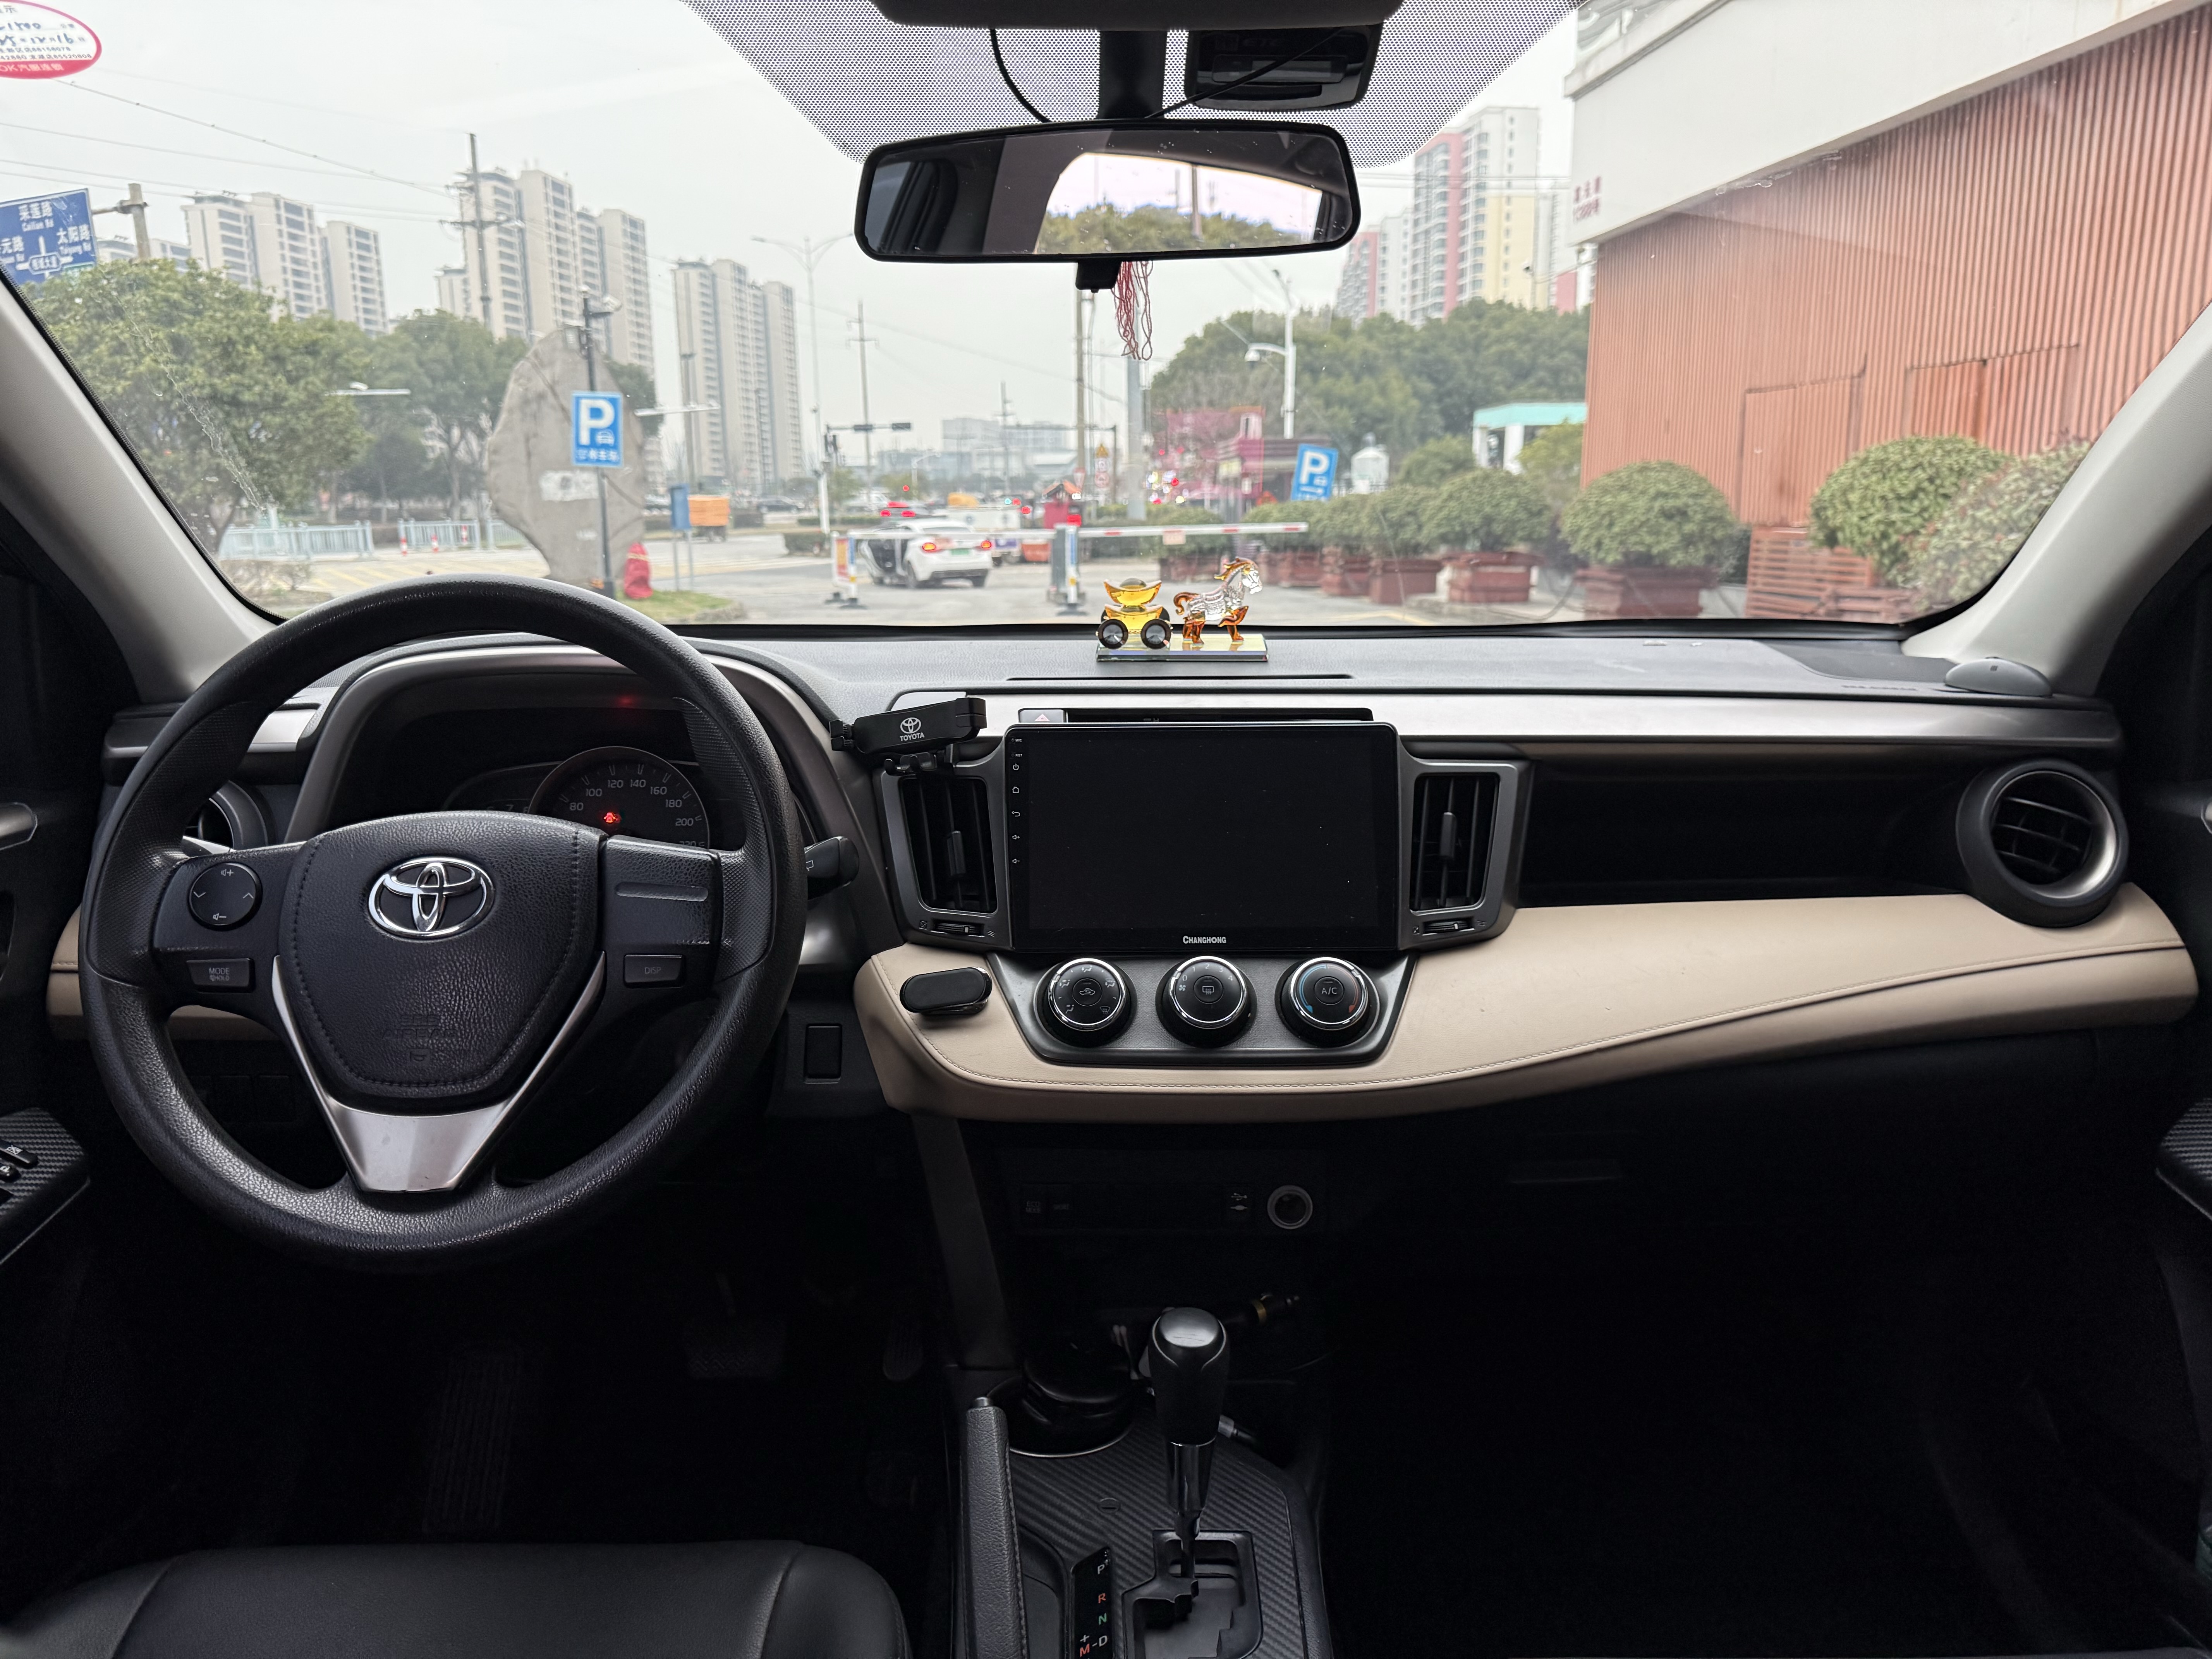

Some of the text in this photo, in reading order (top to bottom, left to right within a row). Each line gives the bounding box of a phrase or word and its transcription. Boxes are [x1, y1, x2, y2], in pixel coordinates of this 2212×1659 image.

[579, 399, 615, 445] P
[1300, 451, 1329, 484] P
[900, 732, 925, 742] TOYOTA
[608, 780, 623, 788] 120
[586, 788, 602, 797] 100
[650, 787, 667, 795] 160
[569, 802, 584, 811] 80
[665, 800, 682, 808] 180
[1321, 986, 1338, 994] A/C
[1097, 1564, 1104, 1574] P
[1098, 1593, 1106, 1603] R
[1098, 1613, 1107, 1625] N
[1098, 1635, 1108, 1647] D
[1079, 1644, 1090, 1657] M
